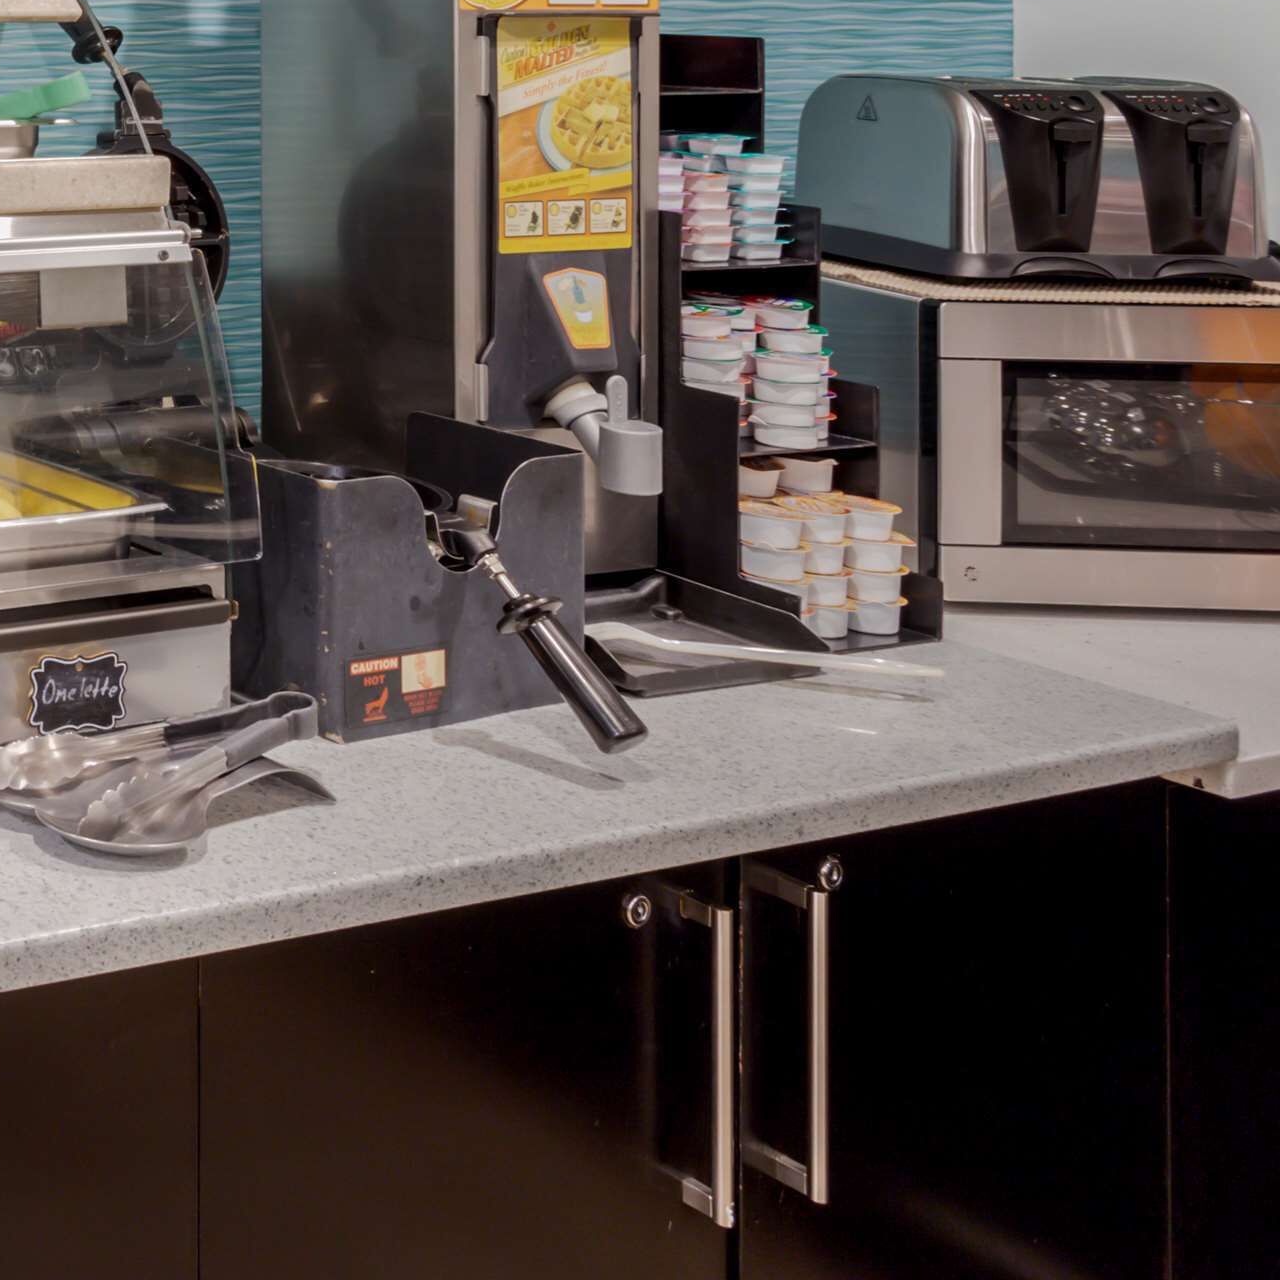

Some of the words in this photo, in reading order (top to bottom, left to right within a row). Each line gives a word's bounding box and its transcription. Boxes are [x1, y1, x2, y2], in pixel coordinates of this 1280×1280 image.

[350, 657, 399, 674] CAUTION
[364, 674, 386, 687] HOT
[41, 676, 119, 705] Omelette
